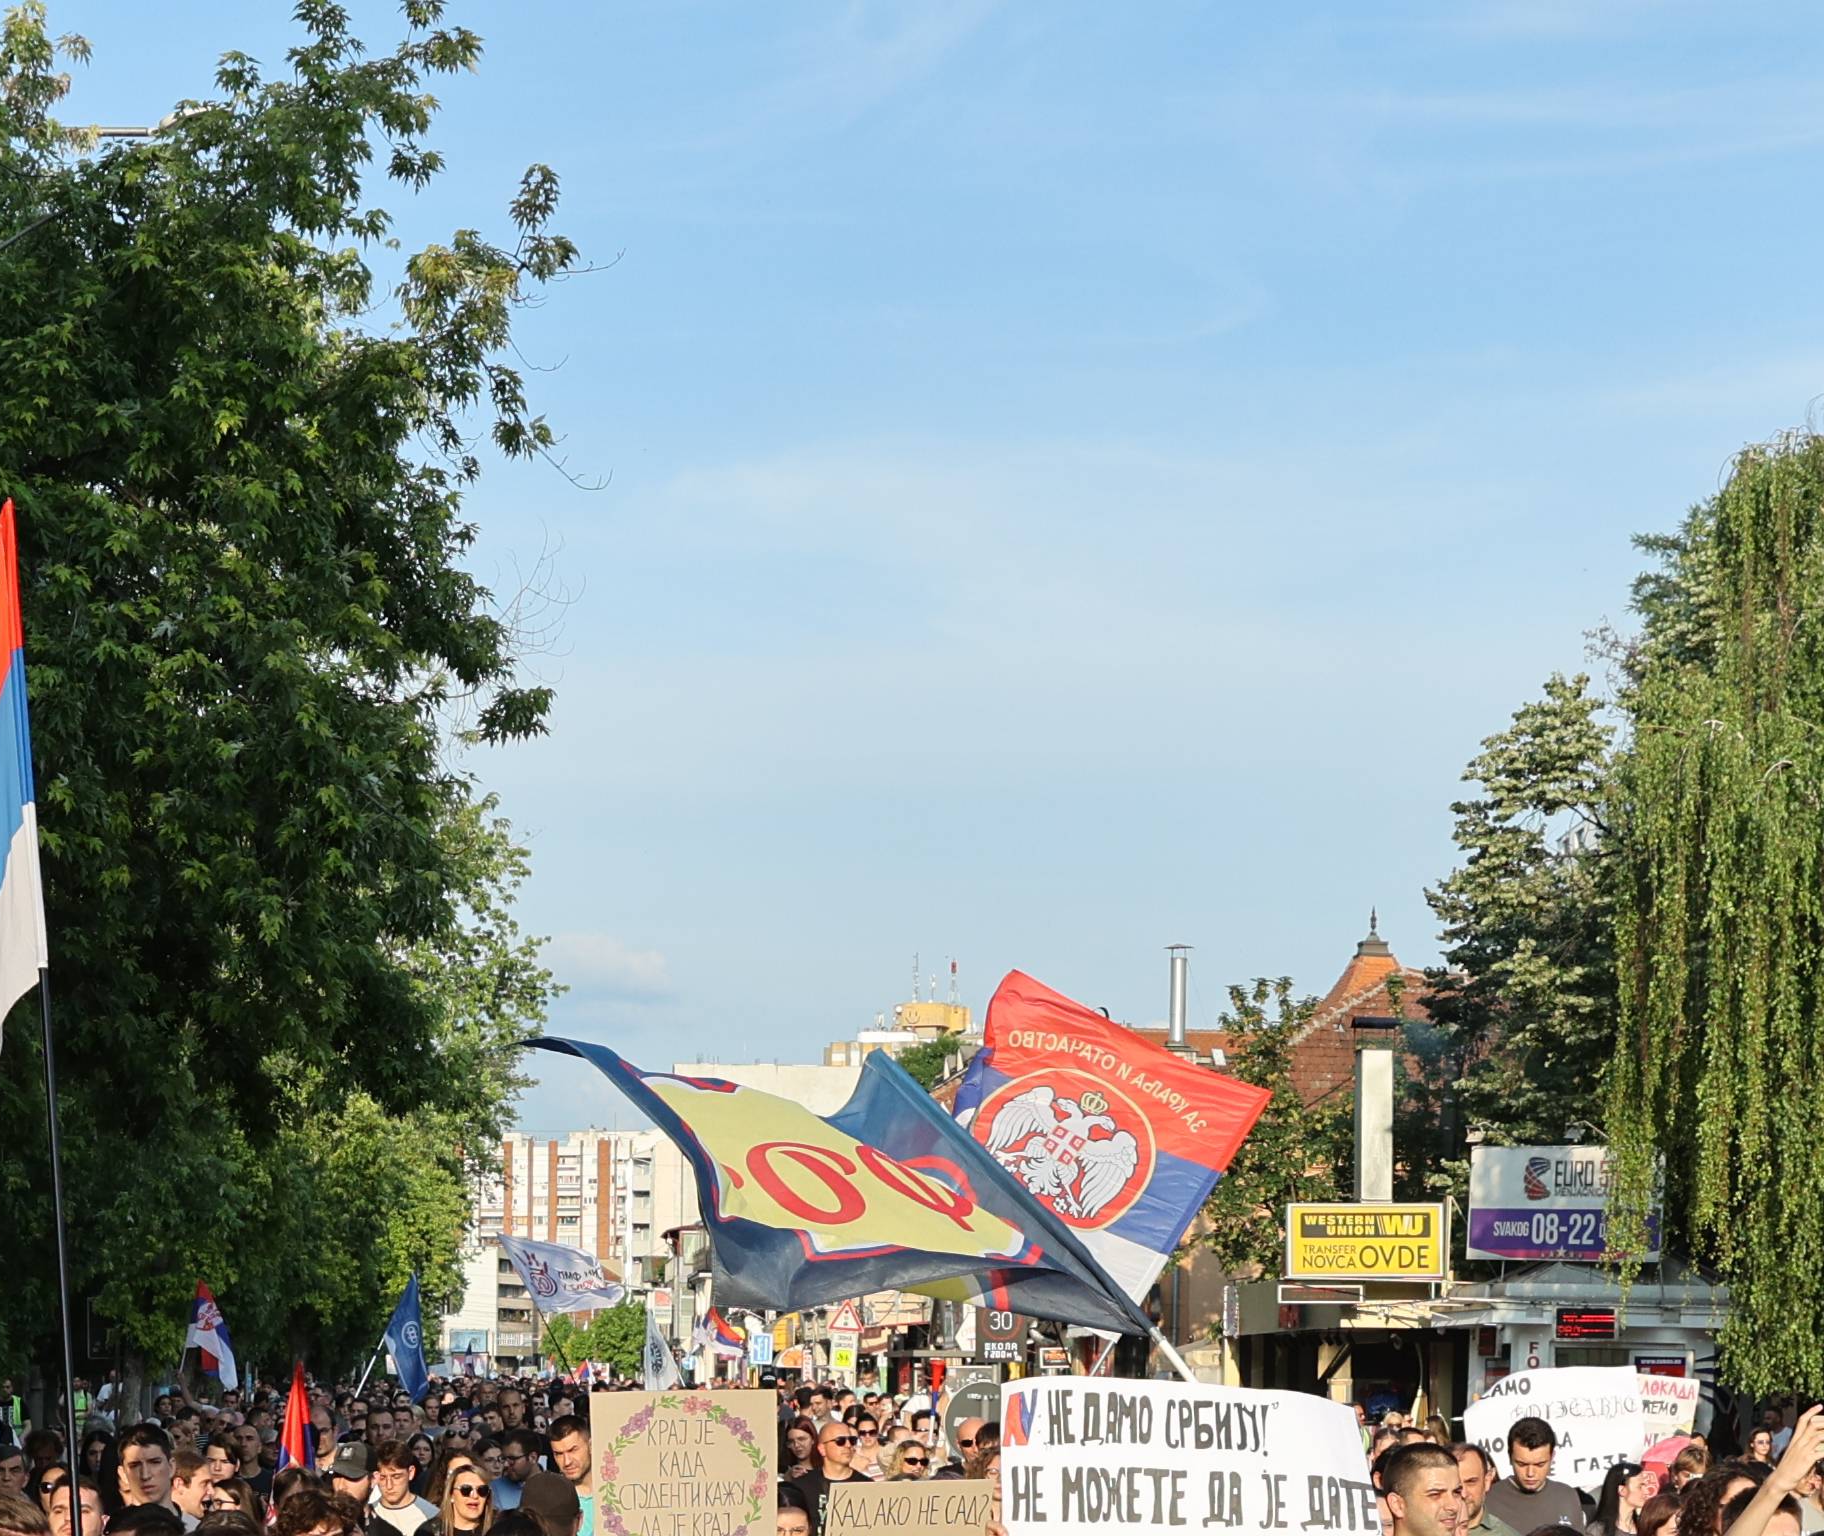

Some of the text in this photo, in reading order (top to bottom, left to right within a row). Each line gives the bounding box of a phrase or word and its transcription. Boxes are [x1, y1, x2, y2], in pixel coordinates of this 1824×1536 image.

[1554, 1160, 1594, 1187] EURO
[1304, 1215, 1375, 1226] WESTERN
[1326, 1225, 1376, 1236] UNION
[1493, 1221, 1530, 1238] SVAKOG
[1531, 1212, 1597, 1246] 08-22
[1302, 1255, 1357, 1269] NOVCA
[1303, 1244, 1430, 1269] TRANSFER OVDE
[989, 1311, 1013, 1330] 30
[1481, 1377, 1532, 1401] АМО
[1639, 1379, 1696, 1401] ЛОКАДА
[647, 1418, 716, 1447] КРАЈ ЈЕ
[1079, 1391, 1154, 1447] ДАМО
[659, 1450, 708, 1479] КАДА
[618, 1479, 747, 1511] СТУДЕНТИ КАЖУ
[1011, 1465, 1048, 1522] НЕ
[1061, 1466, 1188, 1526] МОЖЕТЕ
[1202, 1471, 1244, 1528] ДА
[917, 1495, 941, 1526] НЕ
[944, 1493, 991, 1528] САД?
